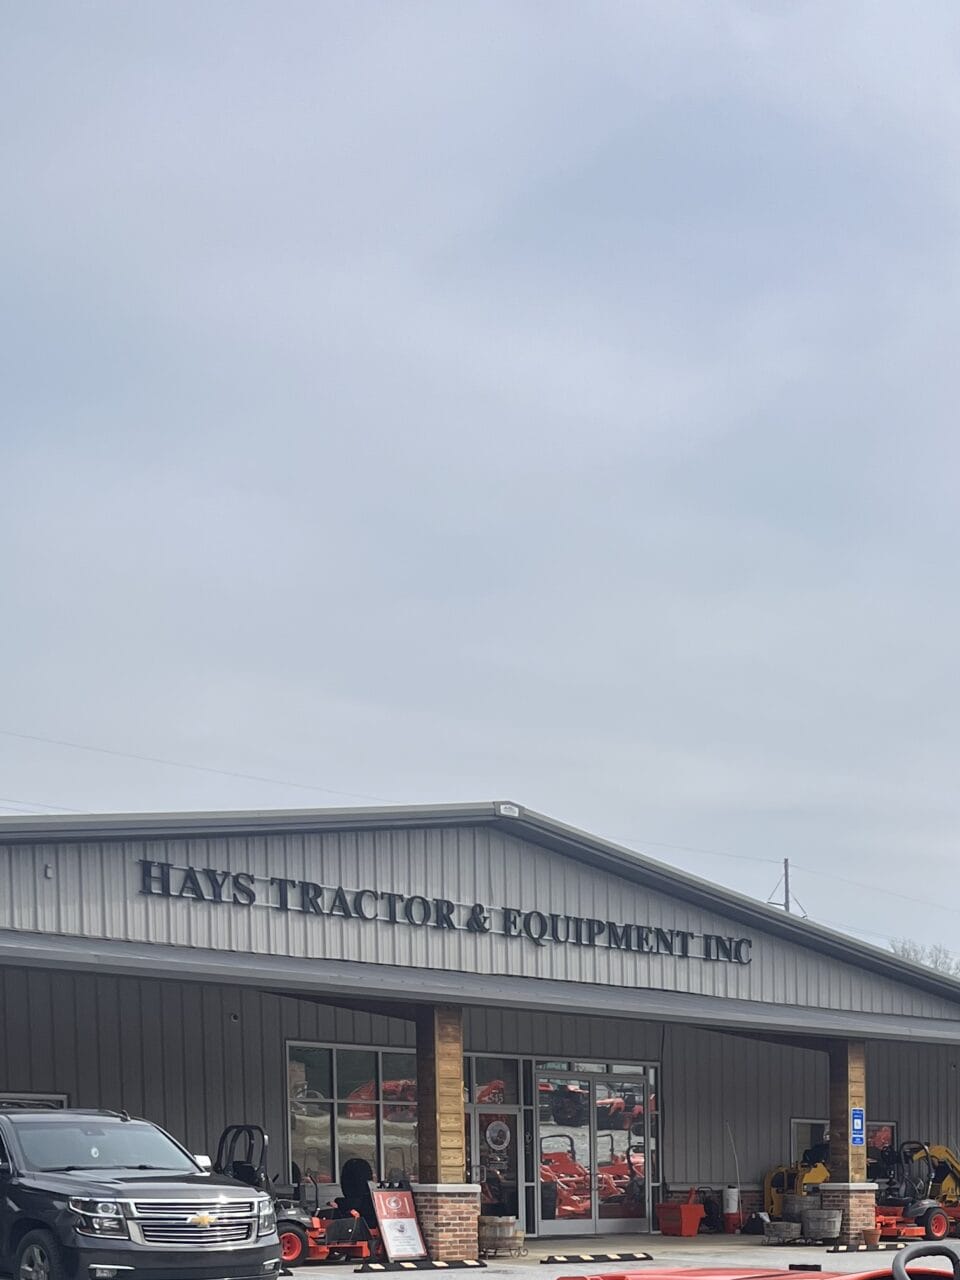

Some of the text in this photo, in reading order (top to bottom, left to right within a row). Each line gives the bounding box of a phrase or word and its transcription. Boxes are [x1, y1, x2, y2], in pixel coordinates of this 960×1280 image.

[138, 858, 753, 965] HAYS TRACTOR & EQUIPMENT INC
